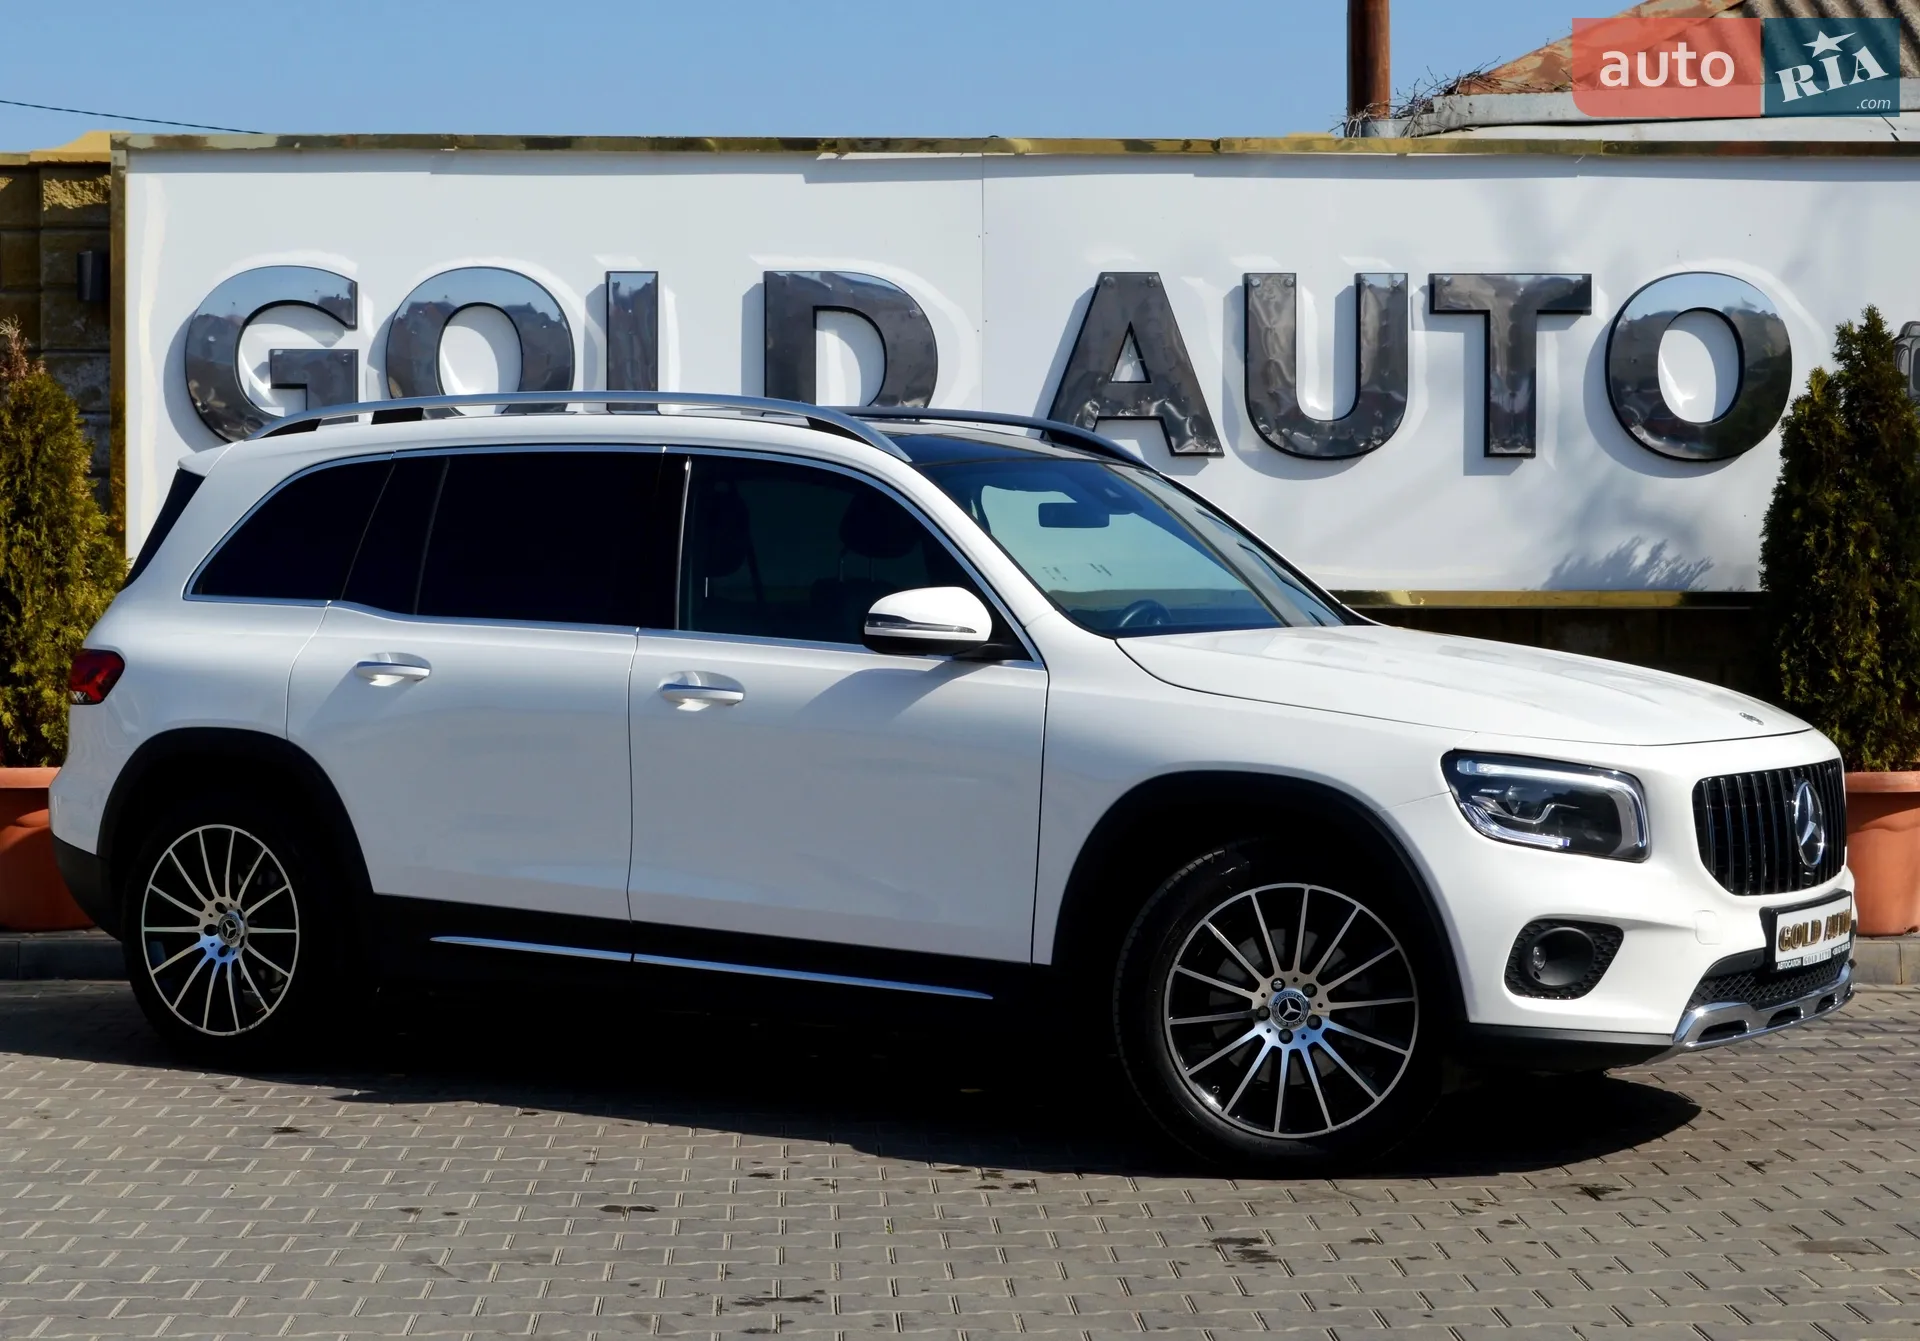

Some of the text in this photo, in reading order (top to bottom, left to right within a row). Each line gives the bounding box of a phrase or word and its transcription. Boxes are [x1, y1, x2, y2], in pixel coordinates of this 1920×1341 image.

[1041, 271, 1793, 462] AUTO
[1779, 919, 1822, 952] GOLD
[1823, 909, 1852, 941] AUTO
